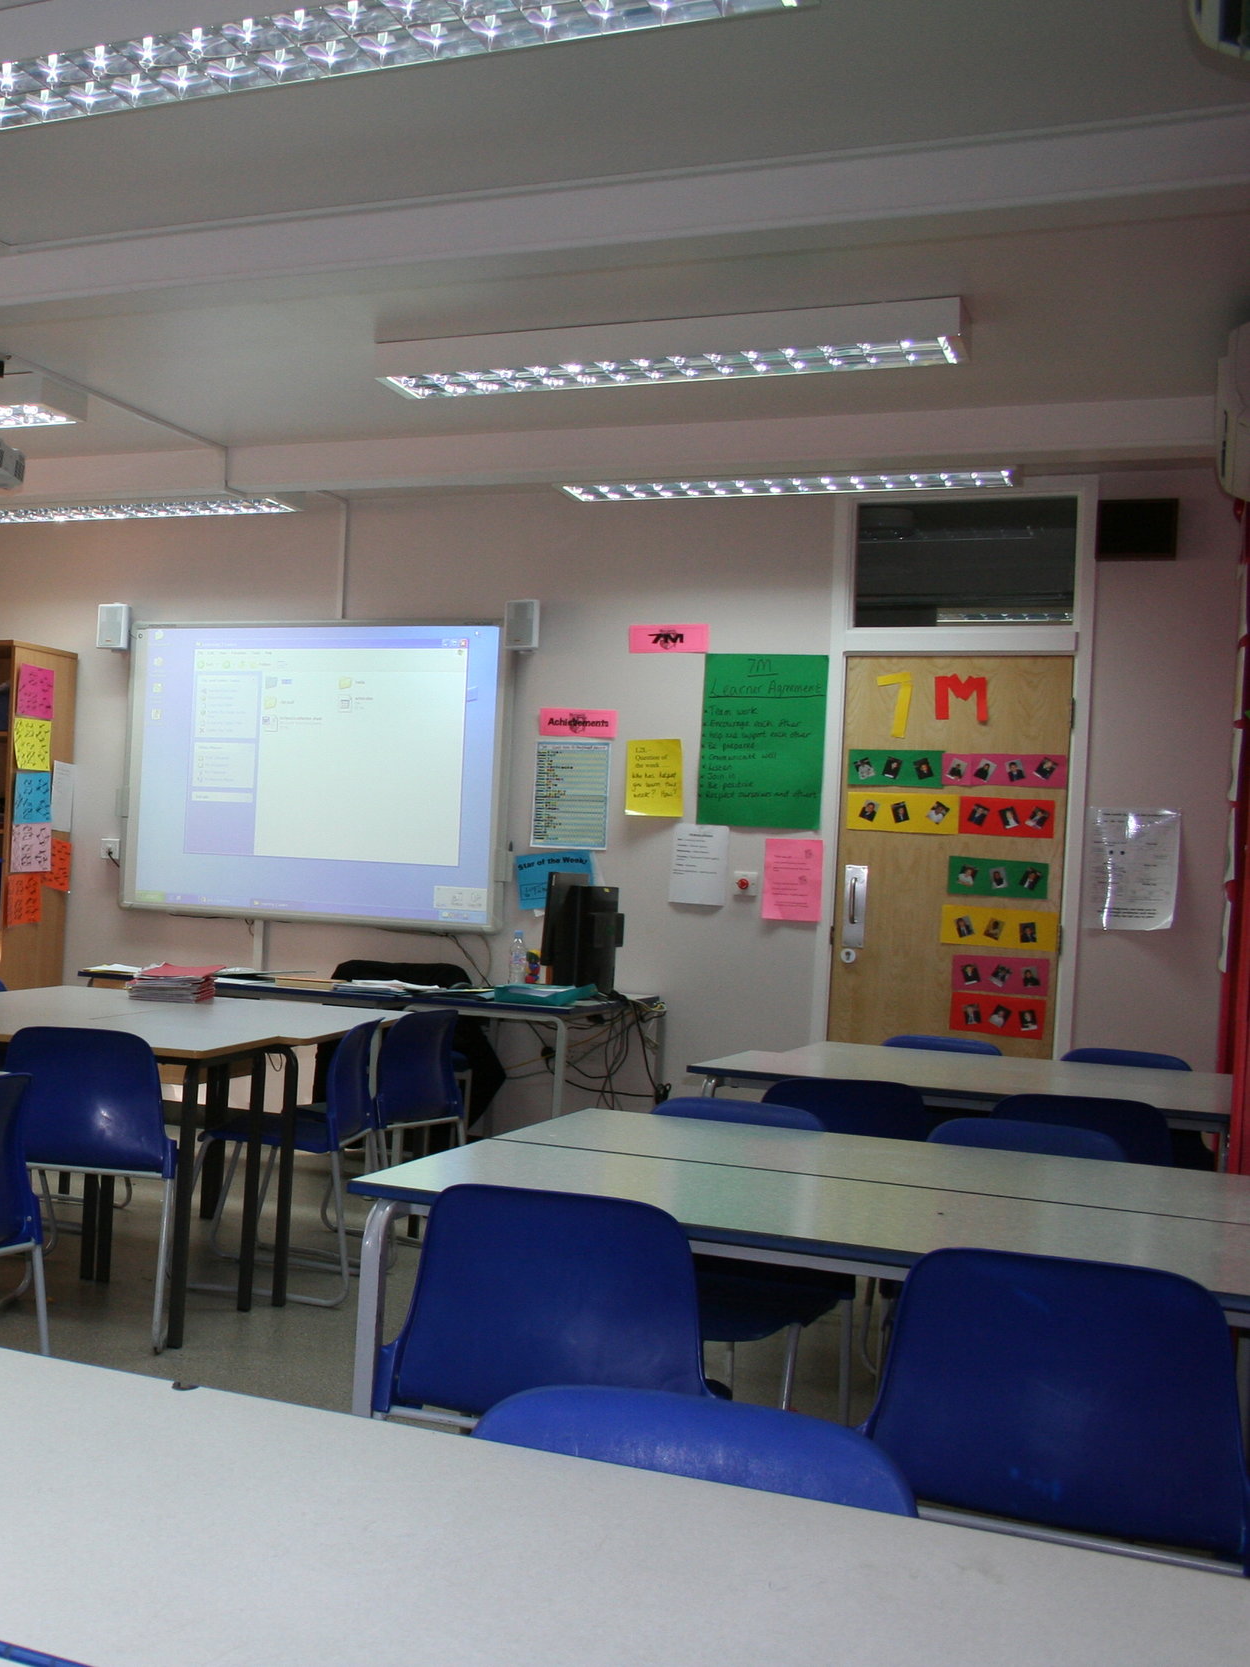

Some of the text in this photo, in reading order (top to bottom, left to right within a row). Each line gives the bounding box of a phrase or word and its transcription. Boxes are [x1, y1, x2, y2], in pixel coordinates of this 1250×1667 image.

[710, 678, 763, 696] Learner
[548, 716, 609, 728] Achievements
[517, 862, 535, 871] Star
